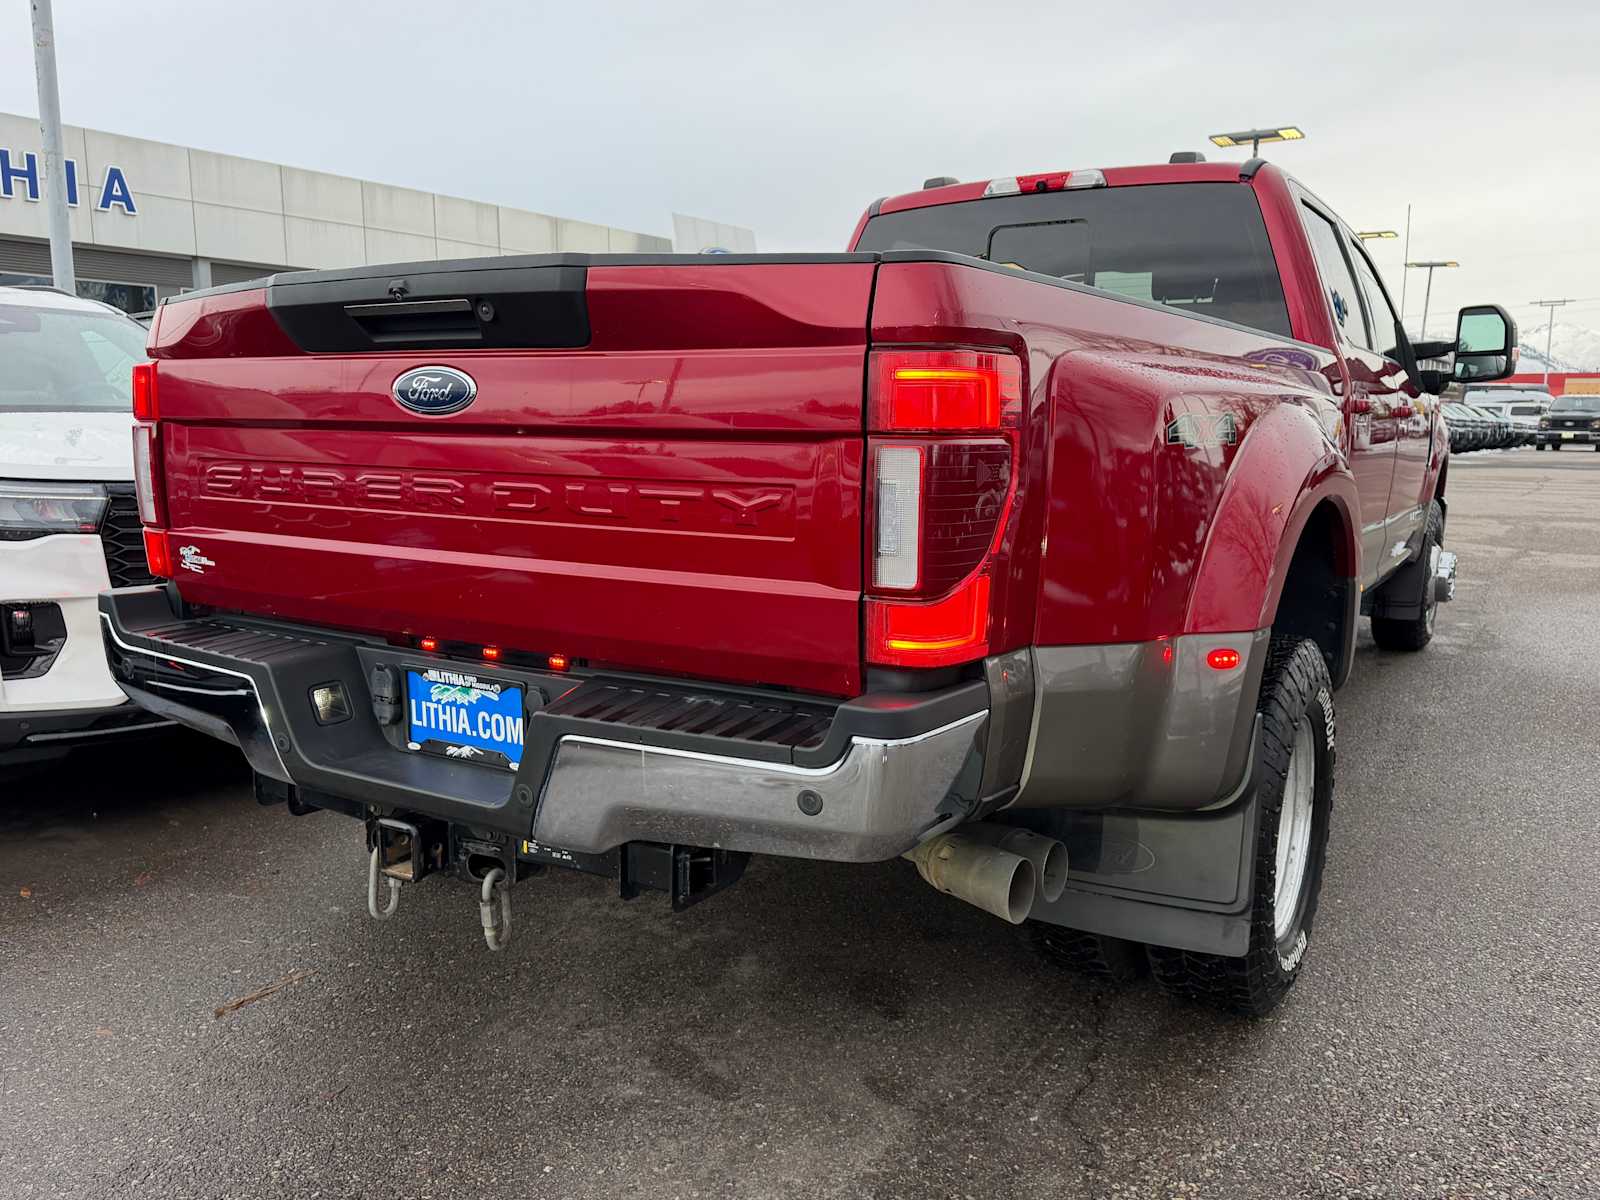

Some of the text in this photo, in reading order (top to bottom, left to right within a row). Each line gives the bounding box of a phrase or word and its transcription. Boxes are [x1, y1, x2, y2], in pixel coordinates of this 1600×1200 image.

[408, 375, 454, 401] Ford
[204, 464, 782, 527] SUPER DUTY
[411, 699, 524, 745] LITHIA.COM
